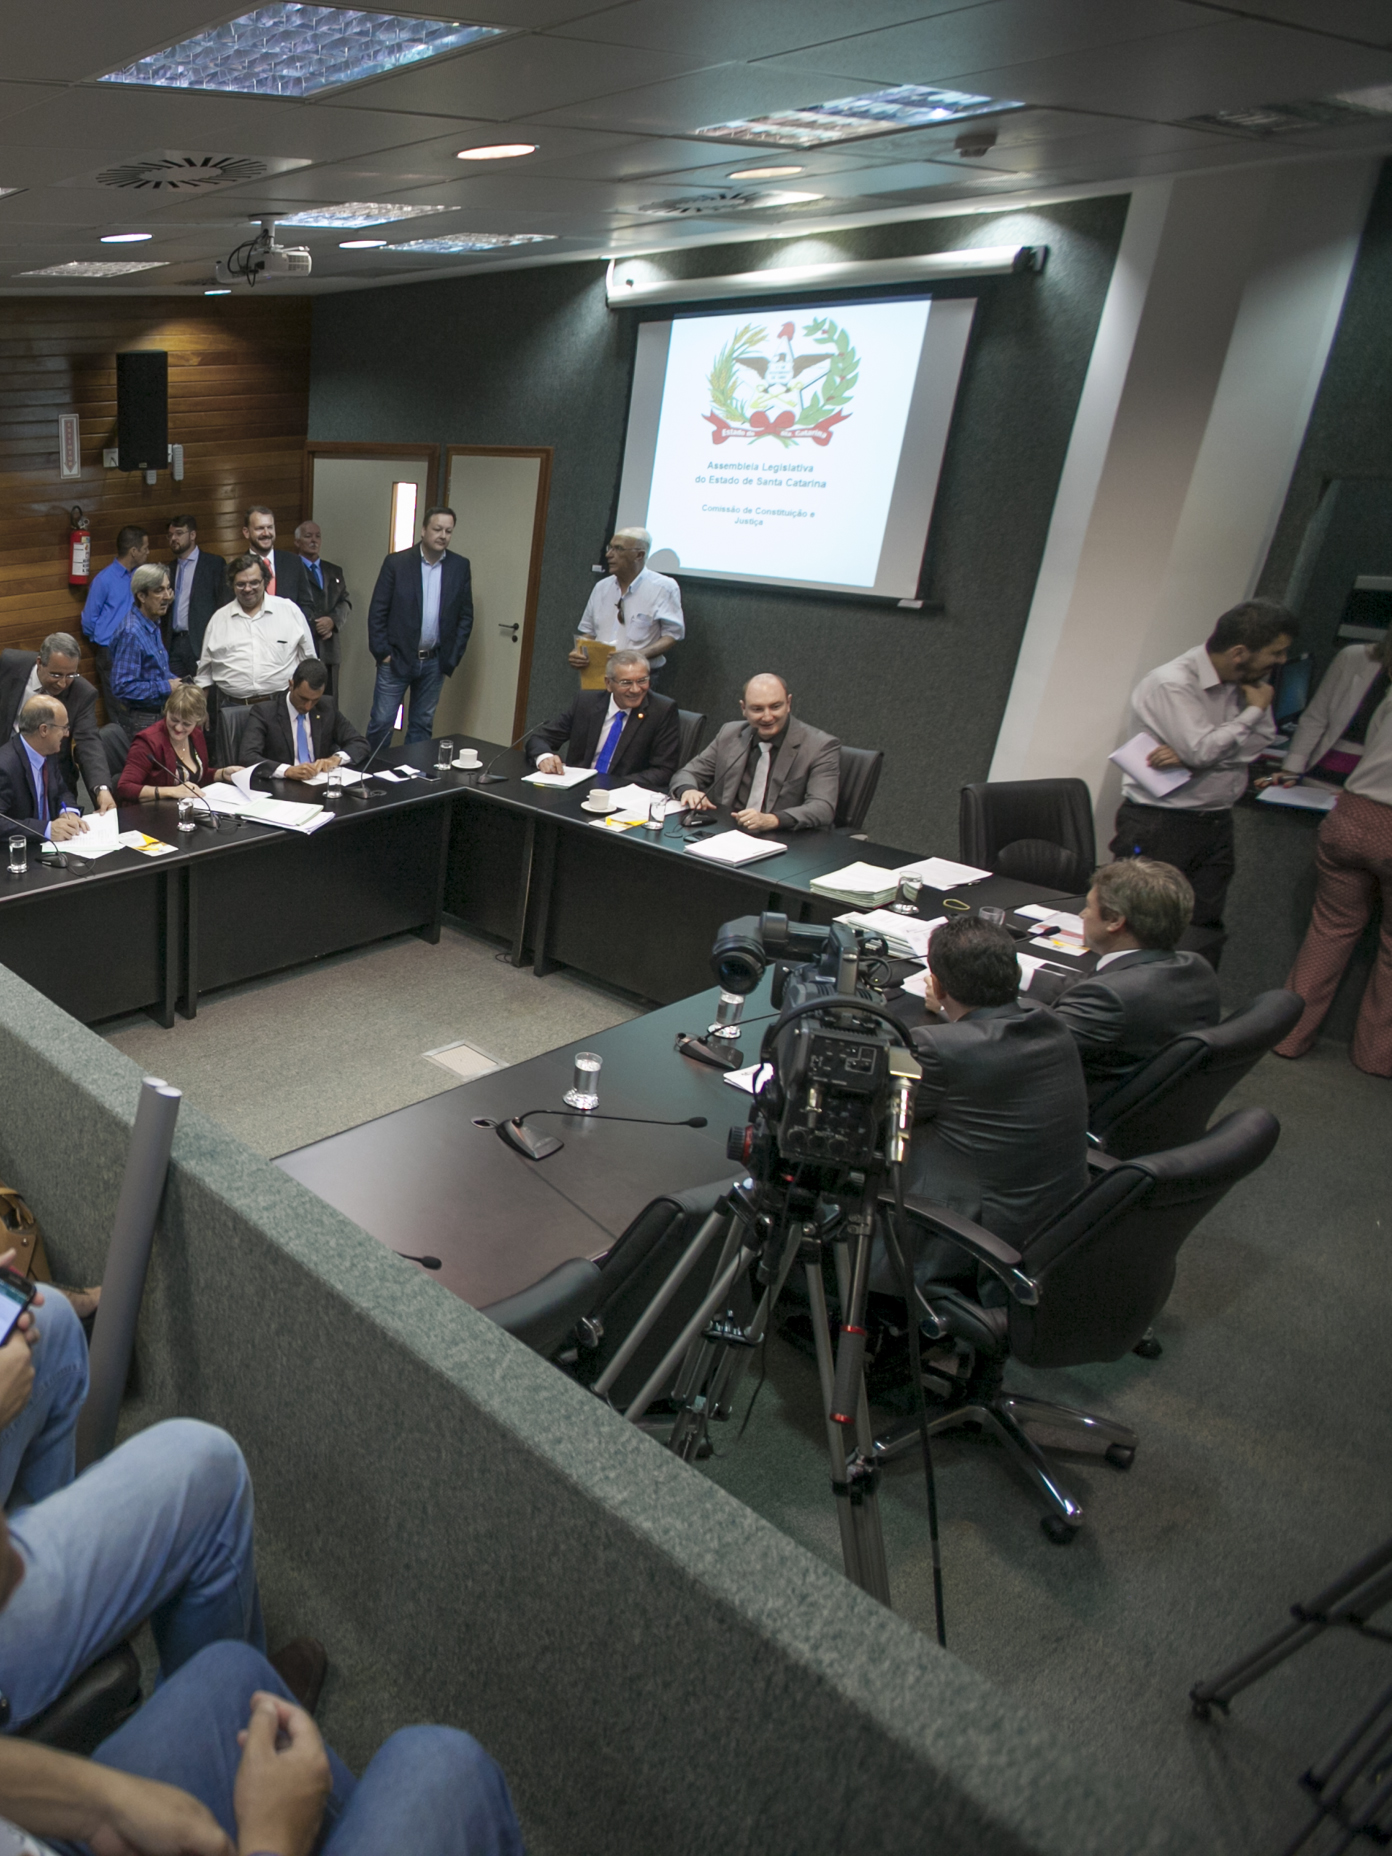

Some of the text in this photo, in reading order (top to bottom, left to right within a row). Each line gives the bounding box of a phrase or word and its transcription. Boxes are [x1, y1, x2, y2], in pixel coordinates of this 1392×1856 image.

[722, 428, 745, 437] Estado
[795, 429, 828, 439] Catarina
[762, 462, 814, 474] Legislativa
[695, 475, 827, 489] do Estado de Santa Catarina
[702, 504, 741, 514] Comissão
[743, 506, 753, 514] de
[755, 507, 808, 519] Constituição
[734, 517, 764, 527] Justiça
